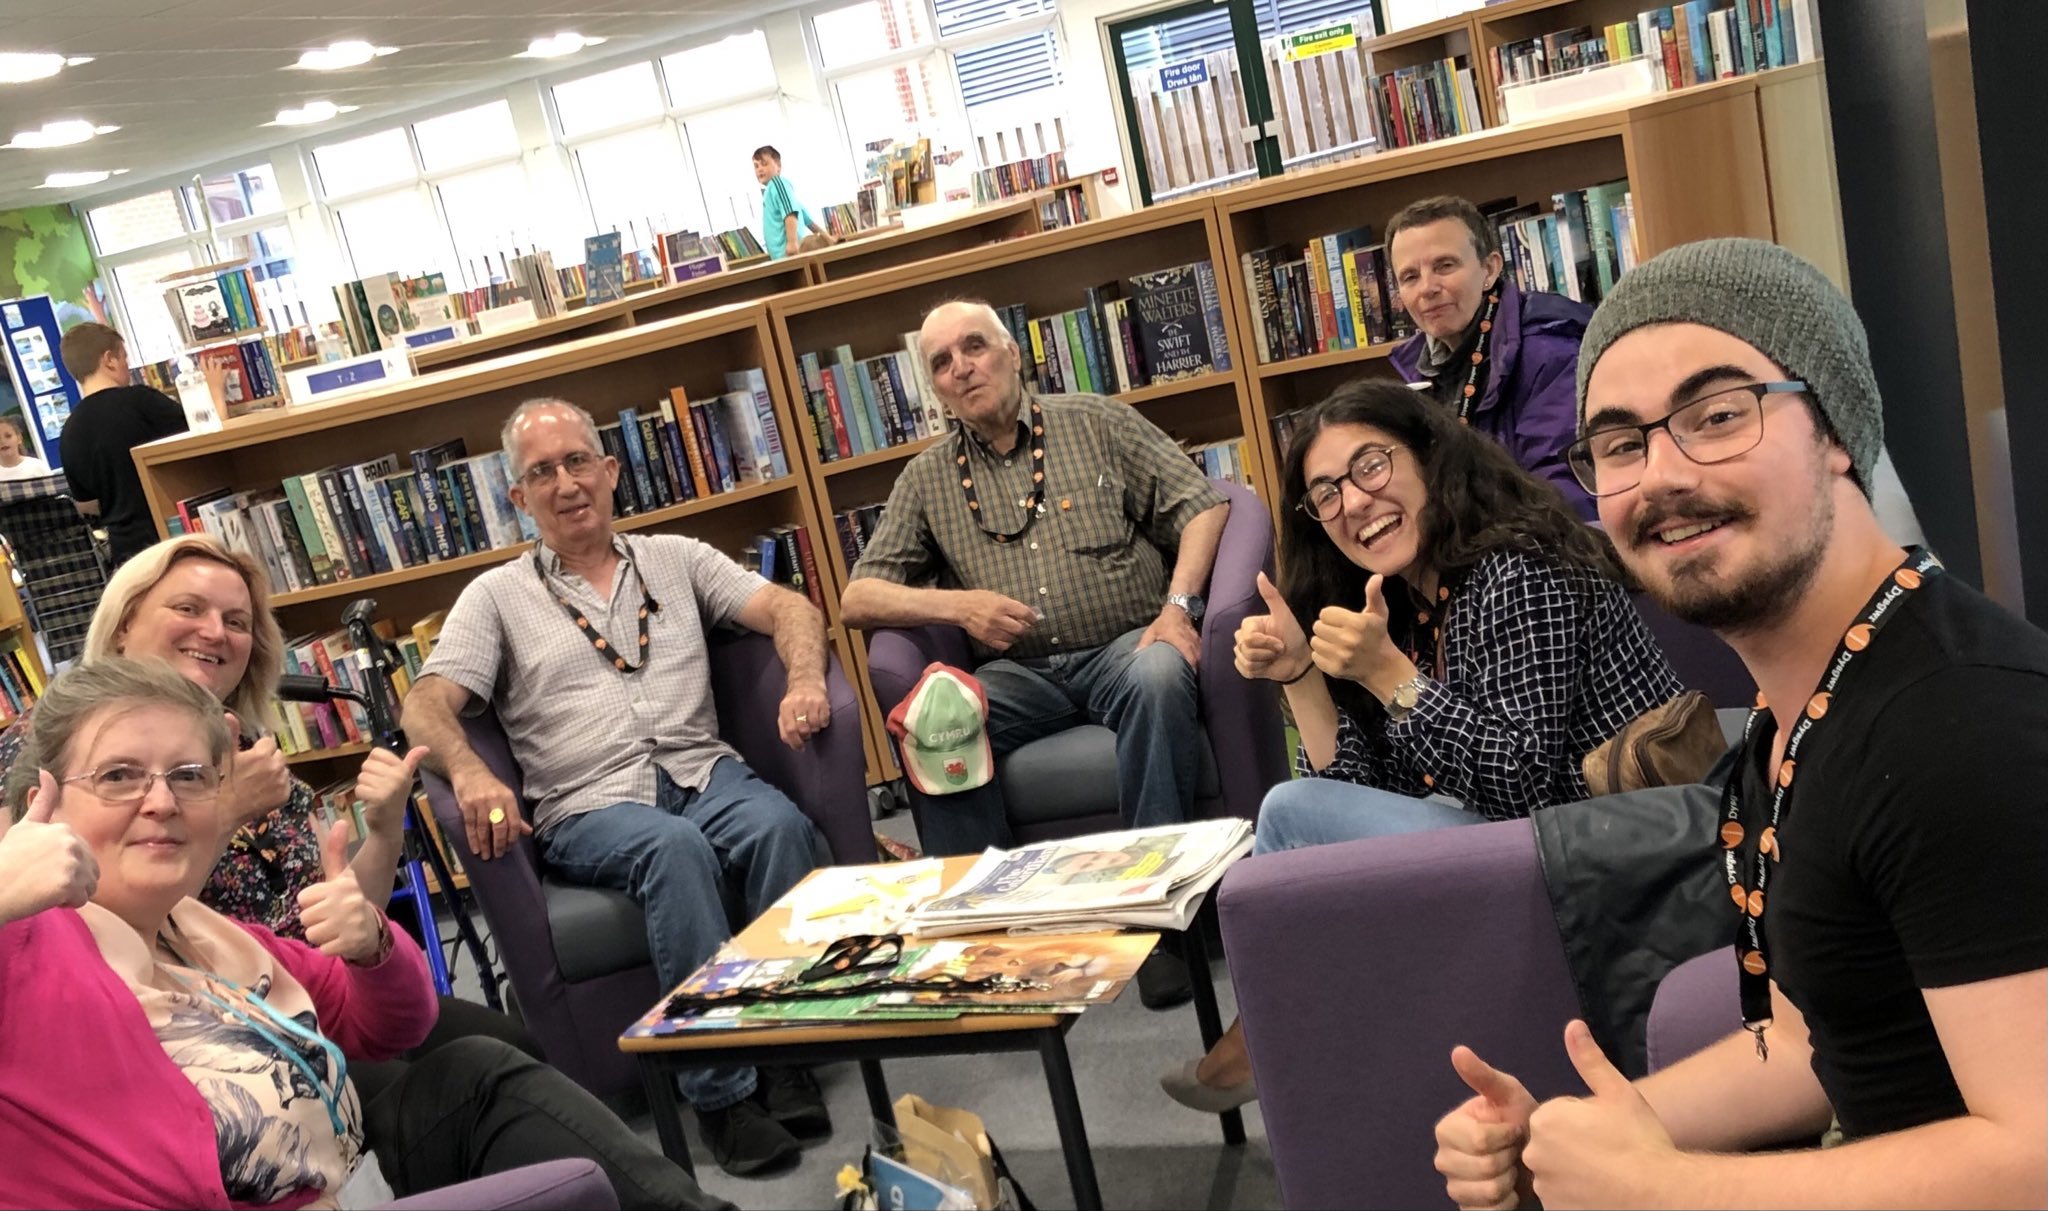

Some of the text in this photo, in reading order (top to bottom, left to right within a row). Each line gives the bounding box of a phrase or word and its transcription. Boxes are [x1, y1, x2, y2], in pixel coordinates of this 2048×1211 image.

[1298, 28, 1346, 43] Fire exit only
[1164, 64, 1201, 78] Fire door
[1167, 78, 1188, 89] Drws
[1138, 286, 1196, 311] MINETTE
[1257, 295, 1270, 319] END
[1141, 302, 1197, 323] WALTERS
[1157, 334, 1191, 351] SWIFT
[1163, 347, 1179, 358] AND
[1210, 325, 1223, 359] HOURS
[1156, 354, 1202, 373] HARRIER
[823, 381, 843, 430] SIX
[640, 421, 658, 461] OLD SINS
[393, 489, 410, 520] FEAR
[419, 471, 439, 513] SAVING
[433, 523, 449, 551] TIME
[786, 537, 800, 572] ASSISTANT
[1871, 585, 1903, 623] Dysgwr
[1827, 651, 1853, 691] Dysgwr
[928, 727, 971, 743] CYMRU
[1789, 719, 1813, 759] Dysgwr
